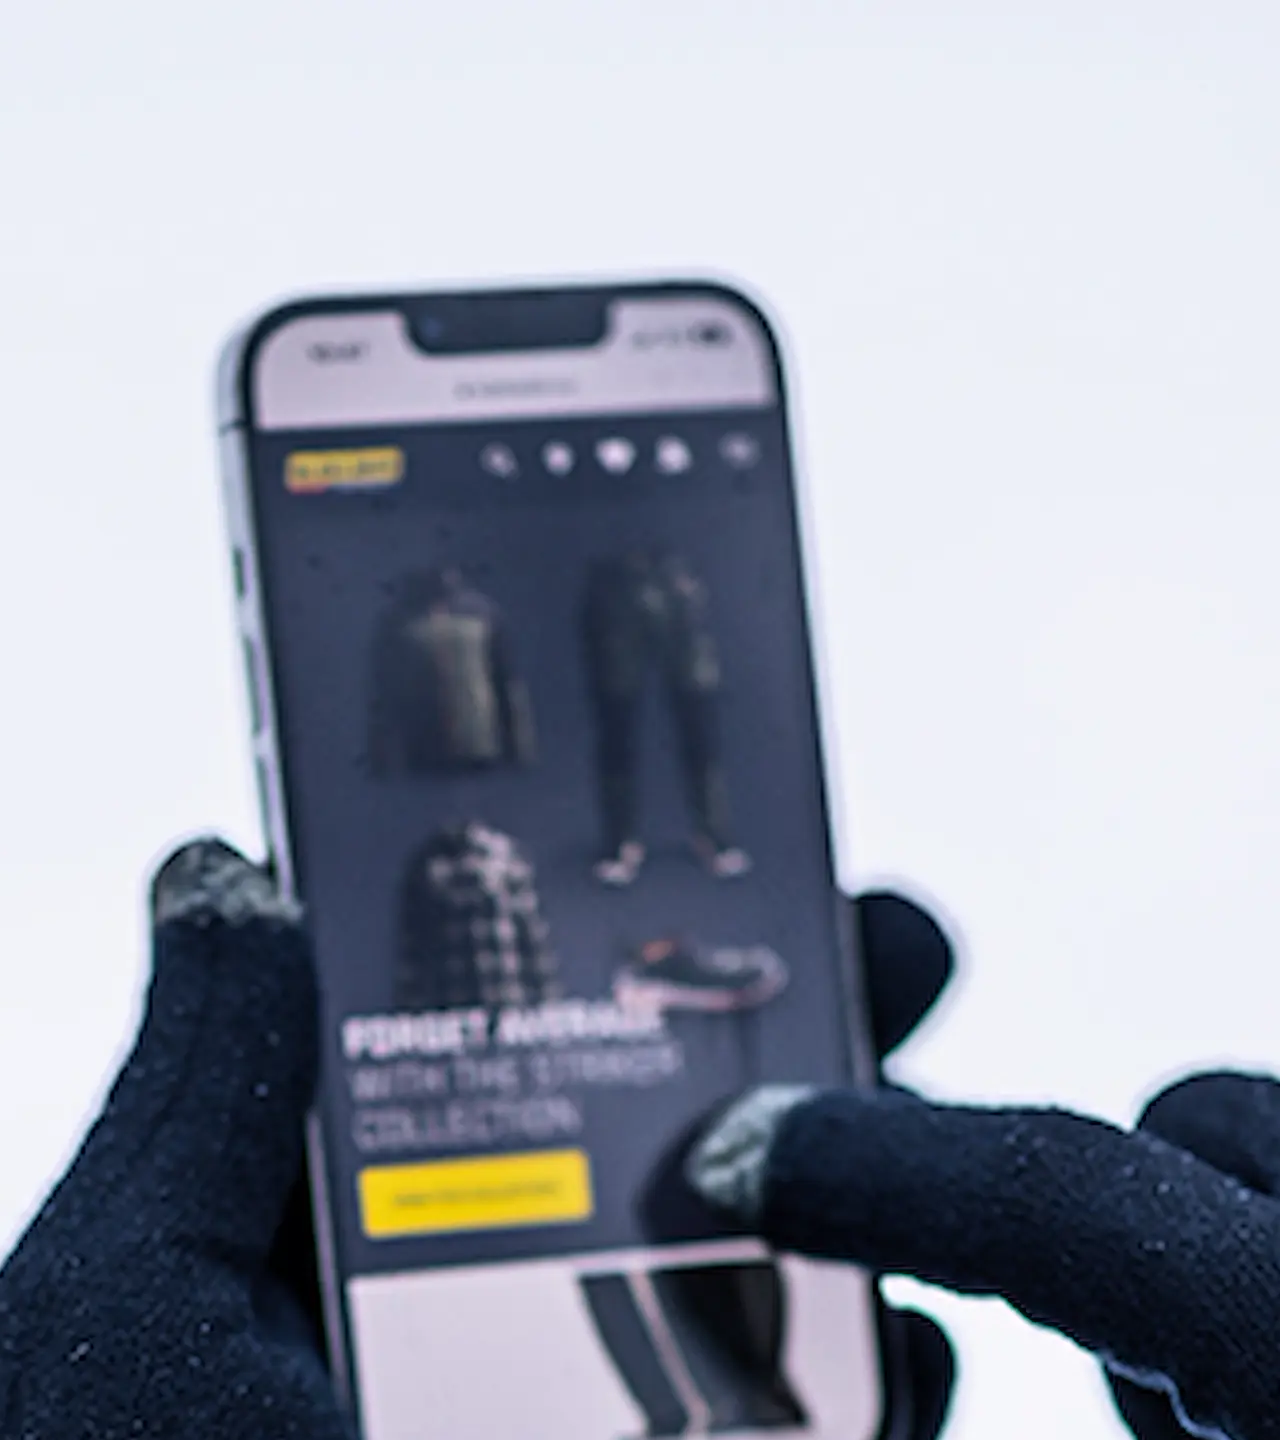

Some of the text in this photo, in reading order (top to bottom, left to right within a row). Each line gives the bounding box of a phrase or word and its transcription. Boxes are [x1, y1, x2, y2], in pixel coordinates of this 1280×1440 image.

[342, 1008, 488, 1059] FORGET
[350, 1060, 448, 1100] WITH
[456, 1057, 519, 1095] THE
[352, 1098, 583, 1151] COLLECTION
